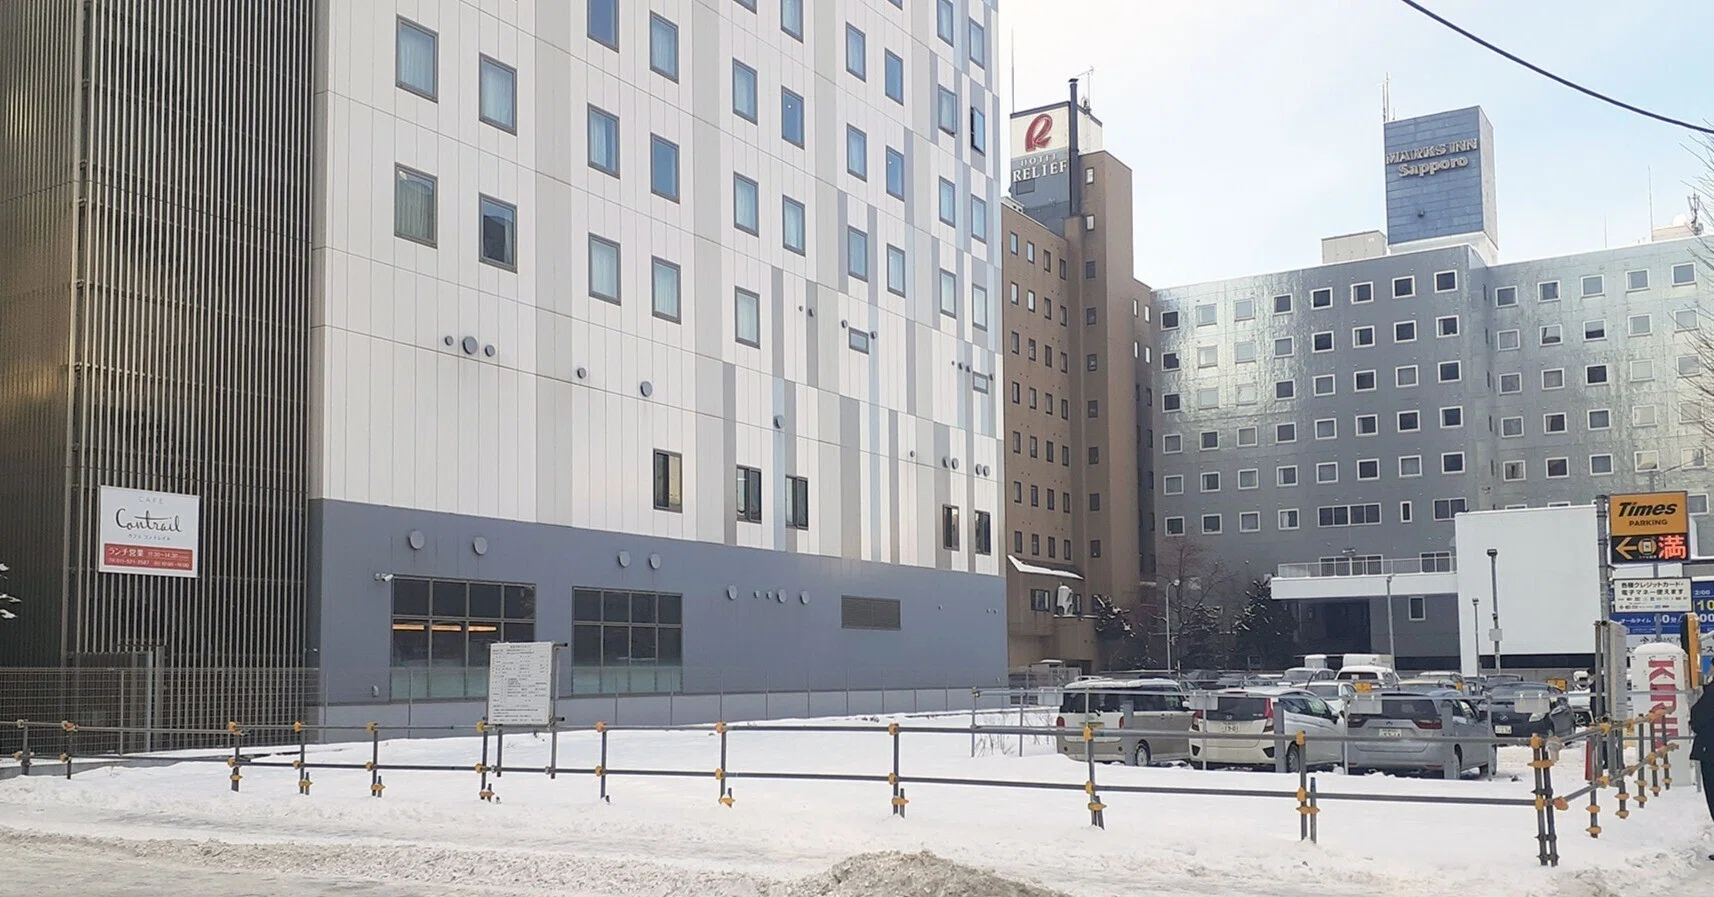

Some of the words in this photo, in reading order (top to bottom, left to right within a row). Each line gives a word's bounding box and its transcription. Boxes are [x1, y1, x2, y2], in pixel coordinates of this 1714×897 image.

[1386, 143, 1447, 165] MARKS
[1449, 138, 1478, 153] INN
[1012, 160, 1068, 182] RELIEF
[1399, 156, 1469, 177] Sapporo
[138, 496, 164, 504] CAFE
[1618, 501, 1678, 517] Times
[115, 508, 182, 532] Contrail
[1629, 519, 1668, 527] PARKING
[108, 547, 144, 557] ランチ営業
[1658, 535, 1687, 559] 満
